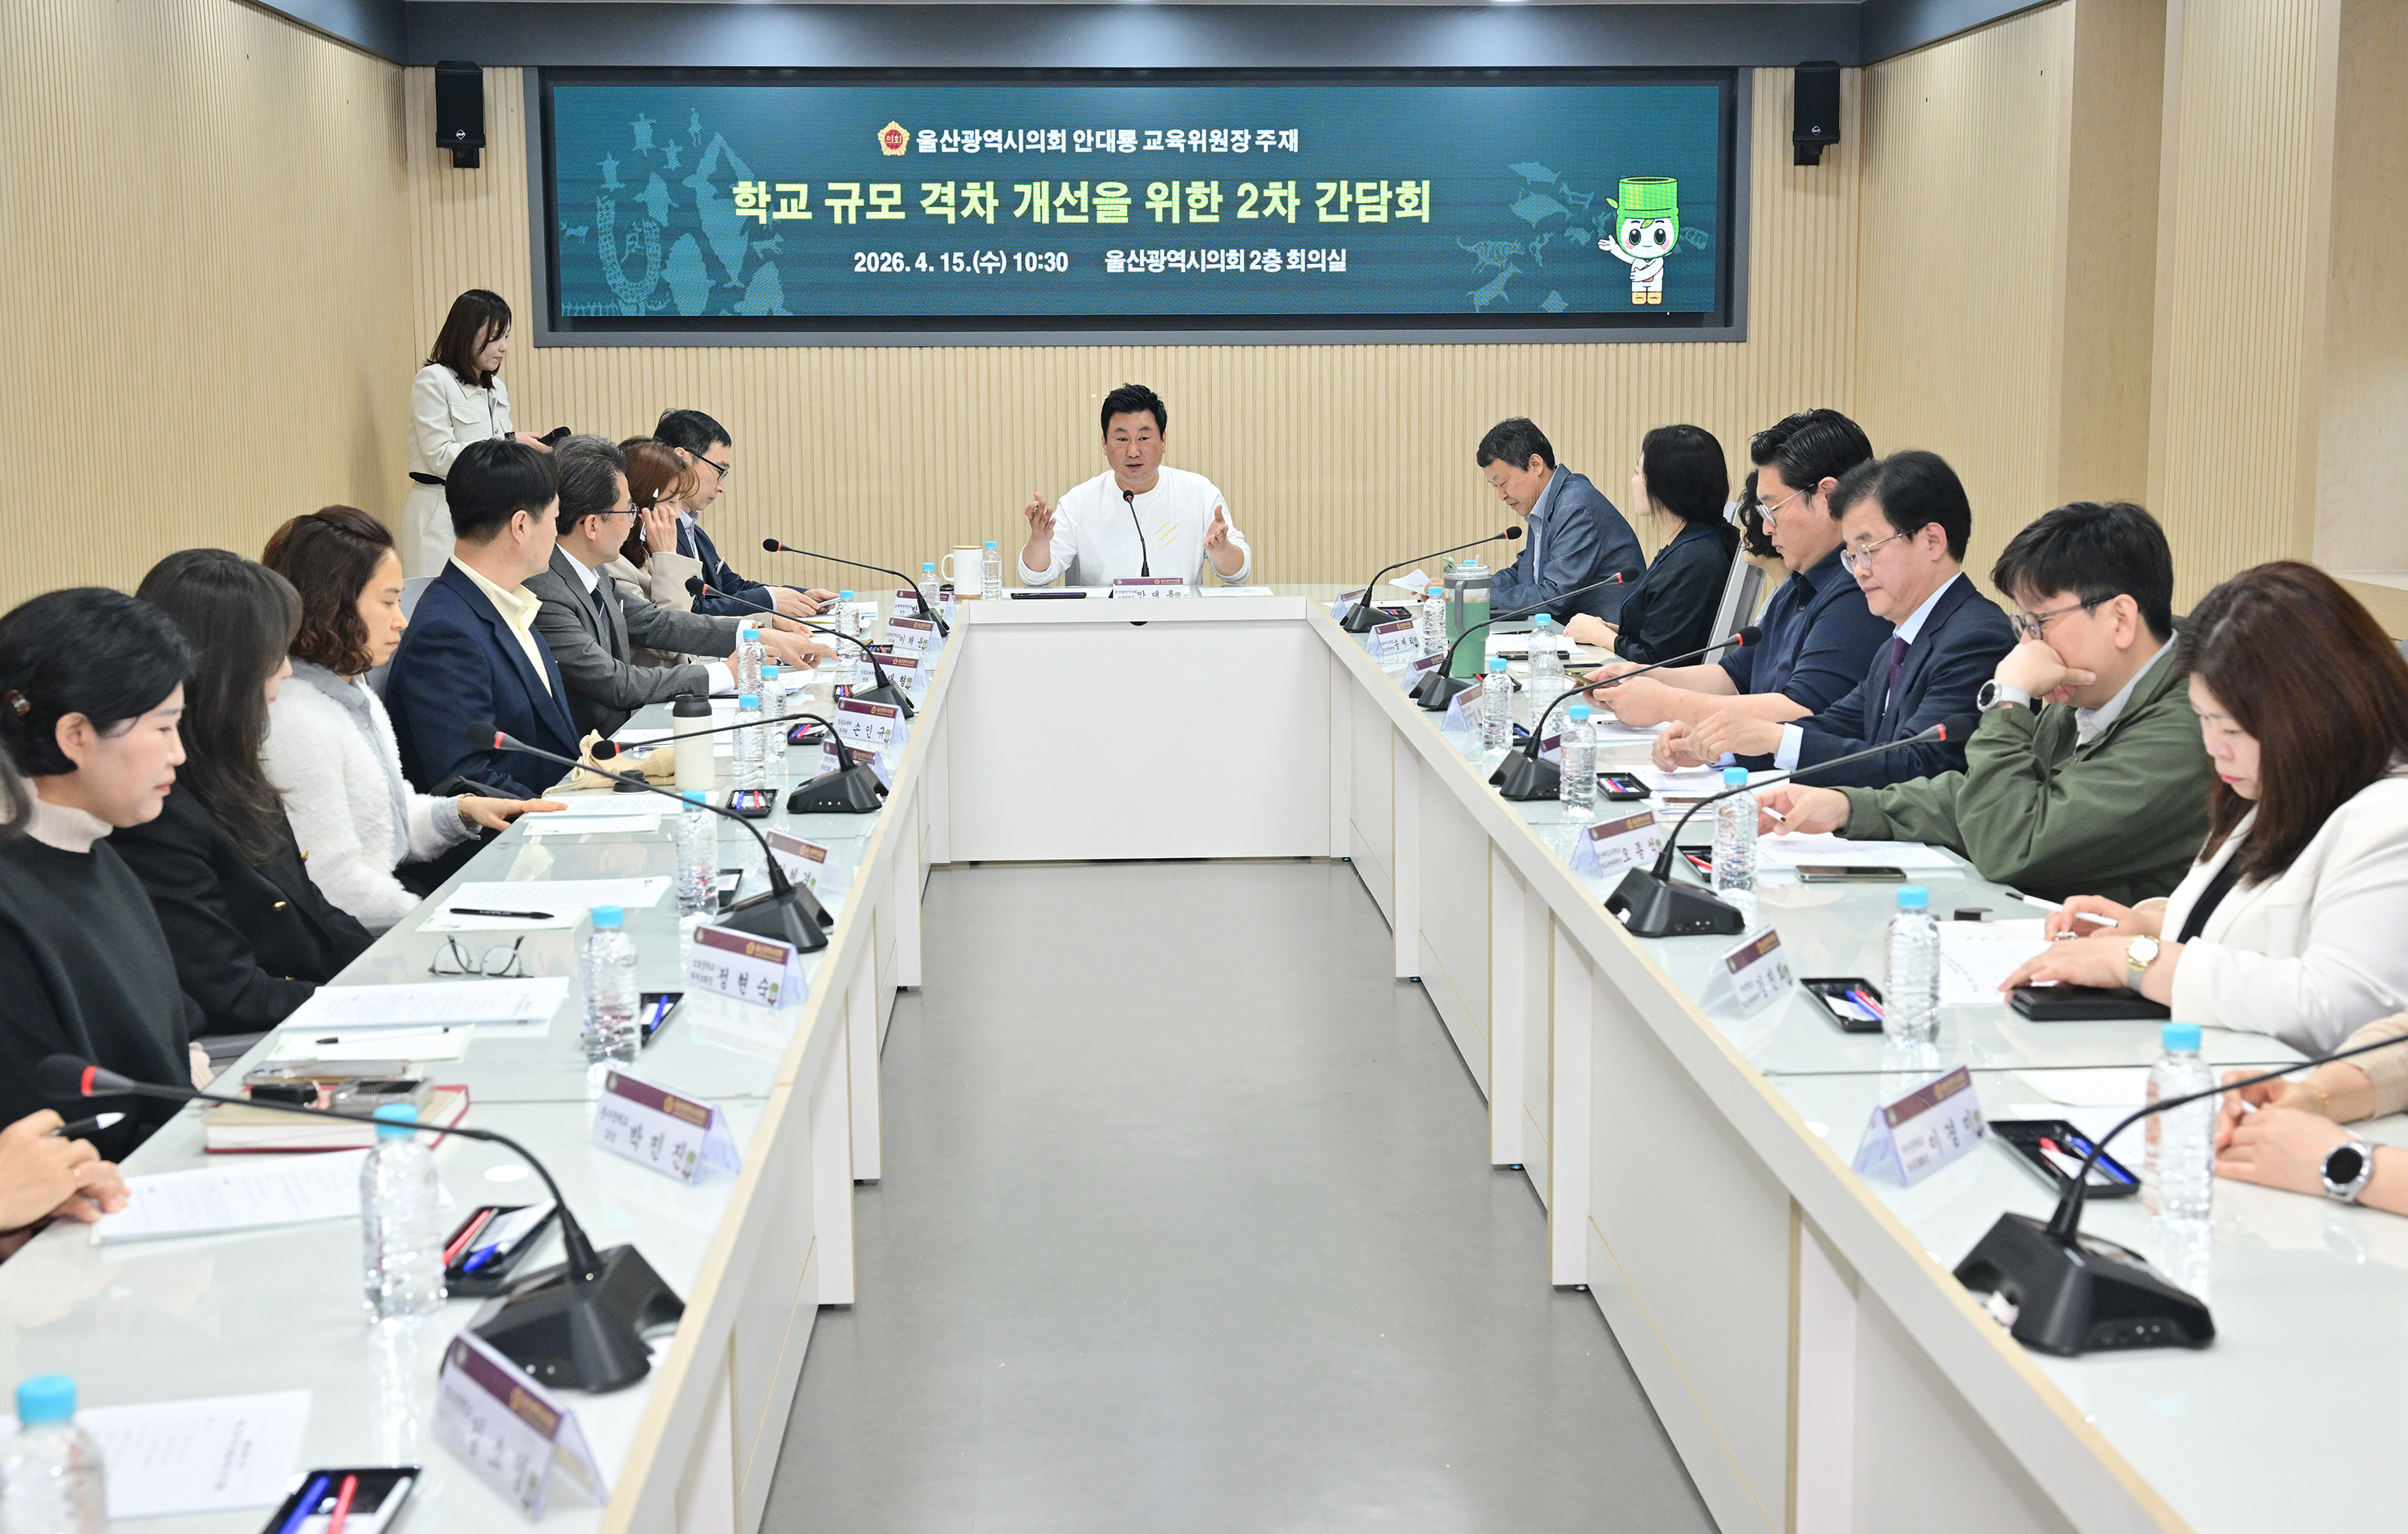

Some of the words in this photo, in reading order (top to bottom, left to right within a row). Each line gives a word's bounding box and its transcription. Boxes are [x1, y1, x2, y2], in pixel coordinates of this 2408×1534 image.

[886, 135, 902, 144] 의회
[916, 128, 1067, 153] 울산광역시의회
[1072, 128, 1138, 153] 안대룡
[1142, 128, 1251, 153] 교육위원장
[1255, 128, 1299, 153] 주재
[732, 181, 812, 225] 학교
[824, 181, 905, 225] 규모
[920, 181, 999, 225] 격차
[1013, 180, 1132, 224] 개선을
[1145, 180, 1223, 224] 위한
[1237, 180, 1300, 224] 2차
[1315, 180, 1430, 223] 간담회
[853, 251, 911, 273] 2026.
[1013, 251, 1068, 272] 10:30
[1104, 249, 1245, 273] 울산광역시의회
[1249, 248, 1283, 273] 2층
[1286, 248, 1347, 273] 회의실
